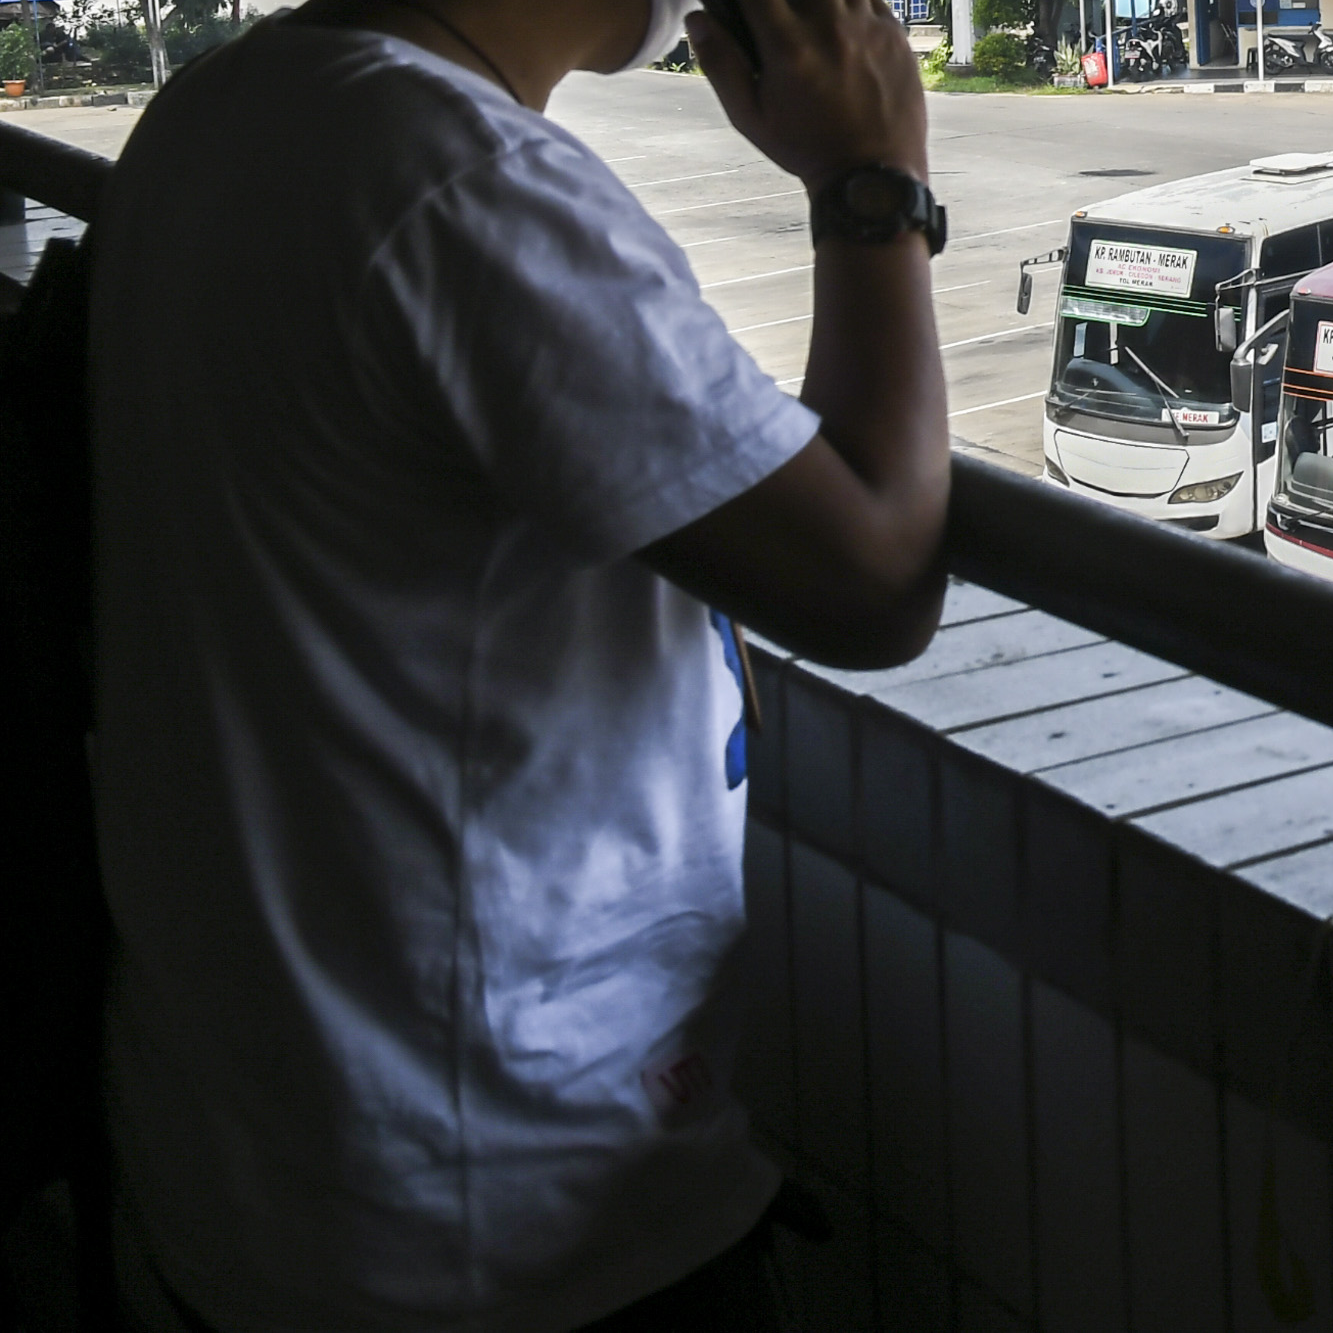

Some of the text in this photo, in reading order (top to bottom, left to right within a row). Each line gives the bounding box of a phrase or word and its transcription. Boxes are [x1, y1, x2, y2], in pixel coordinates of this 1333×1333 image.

[1094, 246, 1105, 260] KP.
[1108, 248, 1152, 265] RAMBUTAN
[1159, 253, 1189, 269] MERAK
